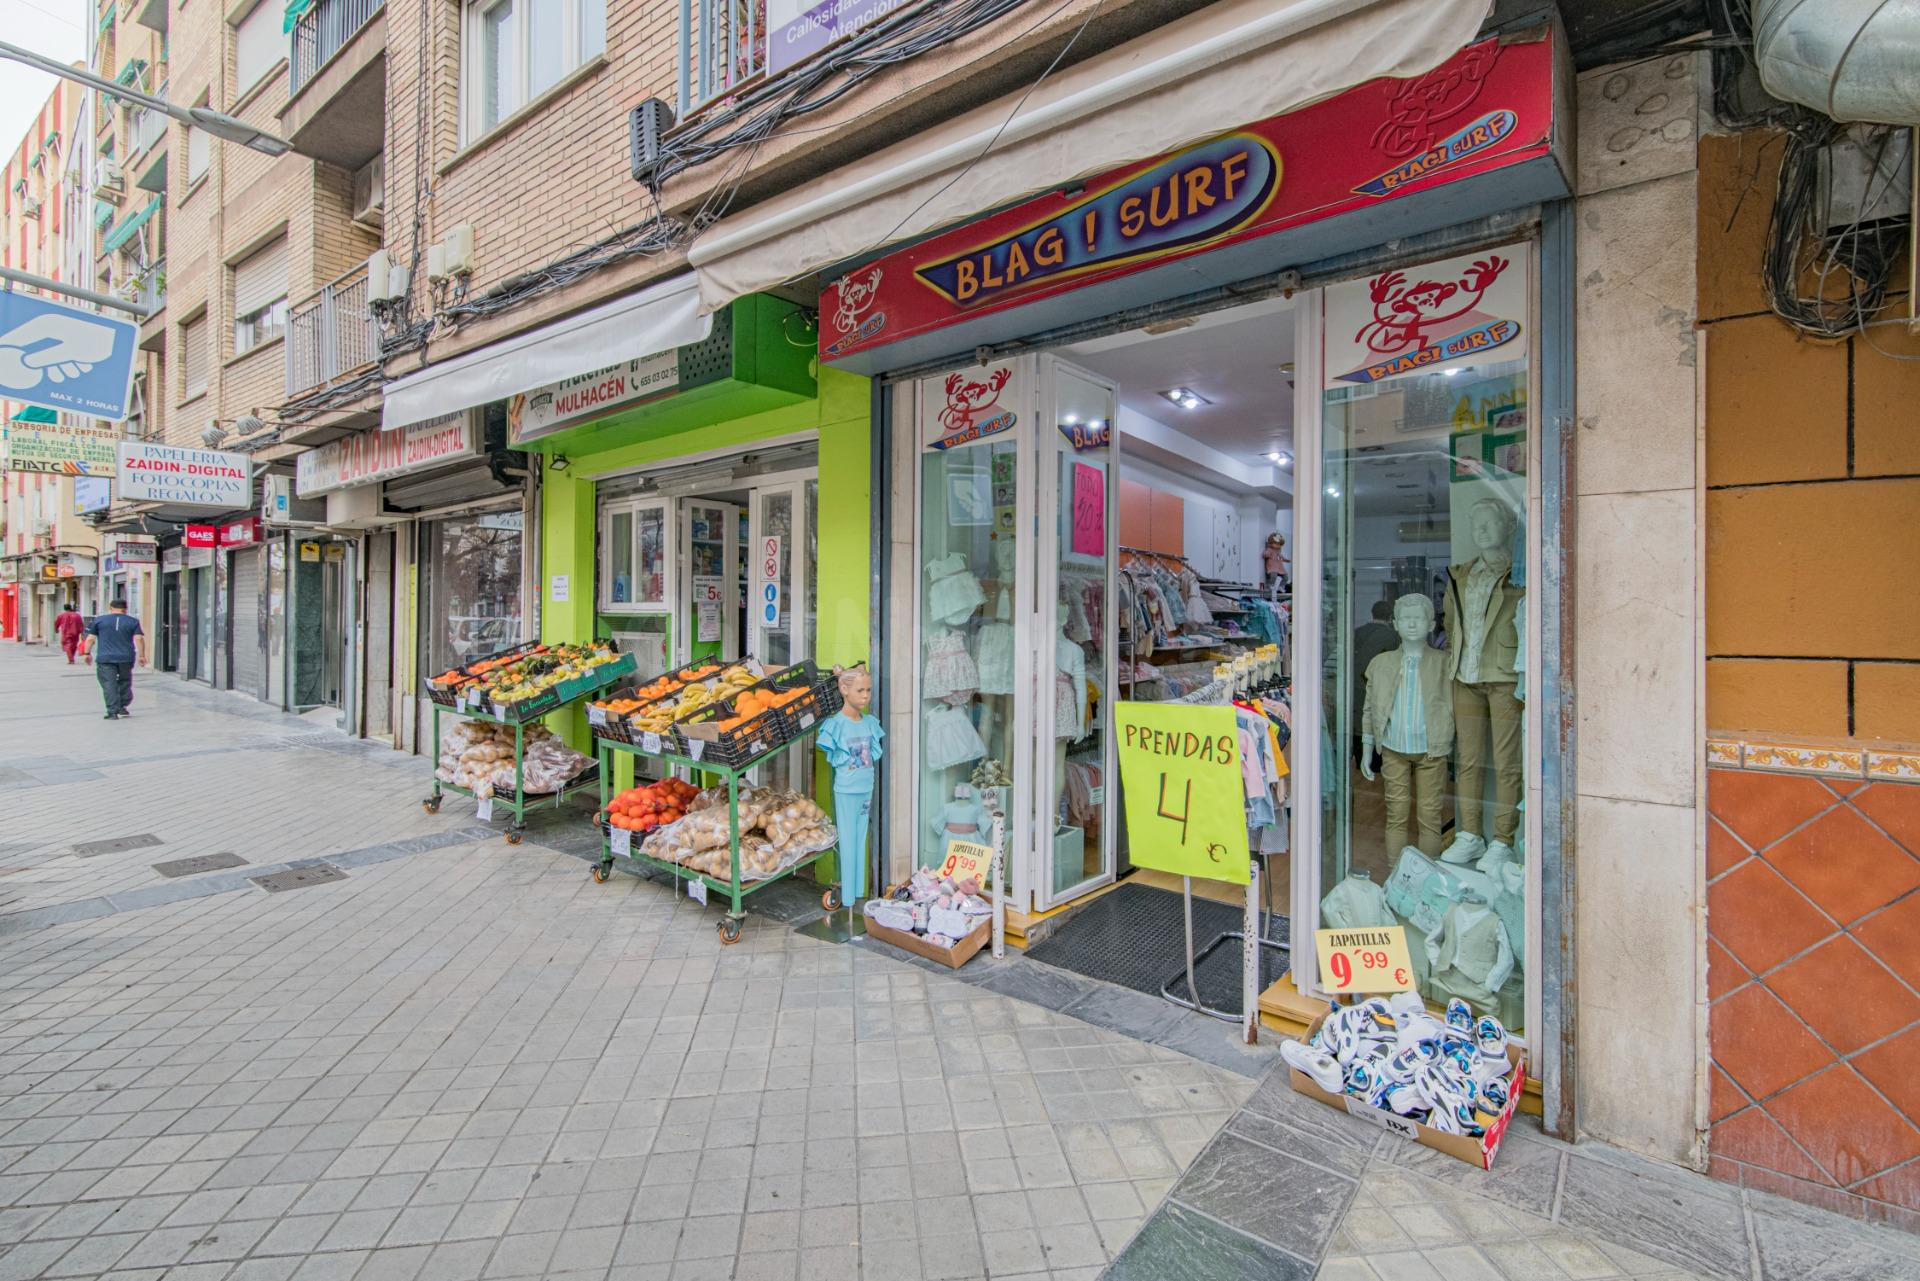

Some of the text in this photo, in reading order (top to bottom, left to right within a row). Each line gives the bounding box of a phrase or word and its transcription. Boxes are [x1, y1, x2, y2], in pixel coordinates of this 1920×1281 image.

[1453, 113, 1507, 155] SURF
[957, 229, 1064, 300] BLAG
[1120, 151, 1248, 238] SURF
[1448, 320, 1510, 354] SURF
[50, 391, 73, 402] MAX
[86, 399, 119, 412] HORAS
[556, 375, 625, 416] MULHACÉN
[12, 423, 119, 439] ASESORIA DE EMPRESAS
[339, 427, 406, 481] ZAIDIN
[408, 426, 464, 463] ZAIDIN-DIGITAL
[145, 446, 228, 465] PAPELERIA
[126, 458, 246, 479] ZAIDIN-DIGITAL
[132, 472, 240, 493] FOTOCOPIAS
[148, 487, 223, 502] REGALOS
[188, 531, 214, 540] GAES
[1125, 724, 1234, 765] PRENDAS
[1157, 772, 1191, 846] 4
[1328, 932, 1392, 948] ZAPATILLAS
[1394, 968, 1408, 986] €
